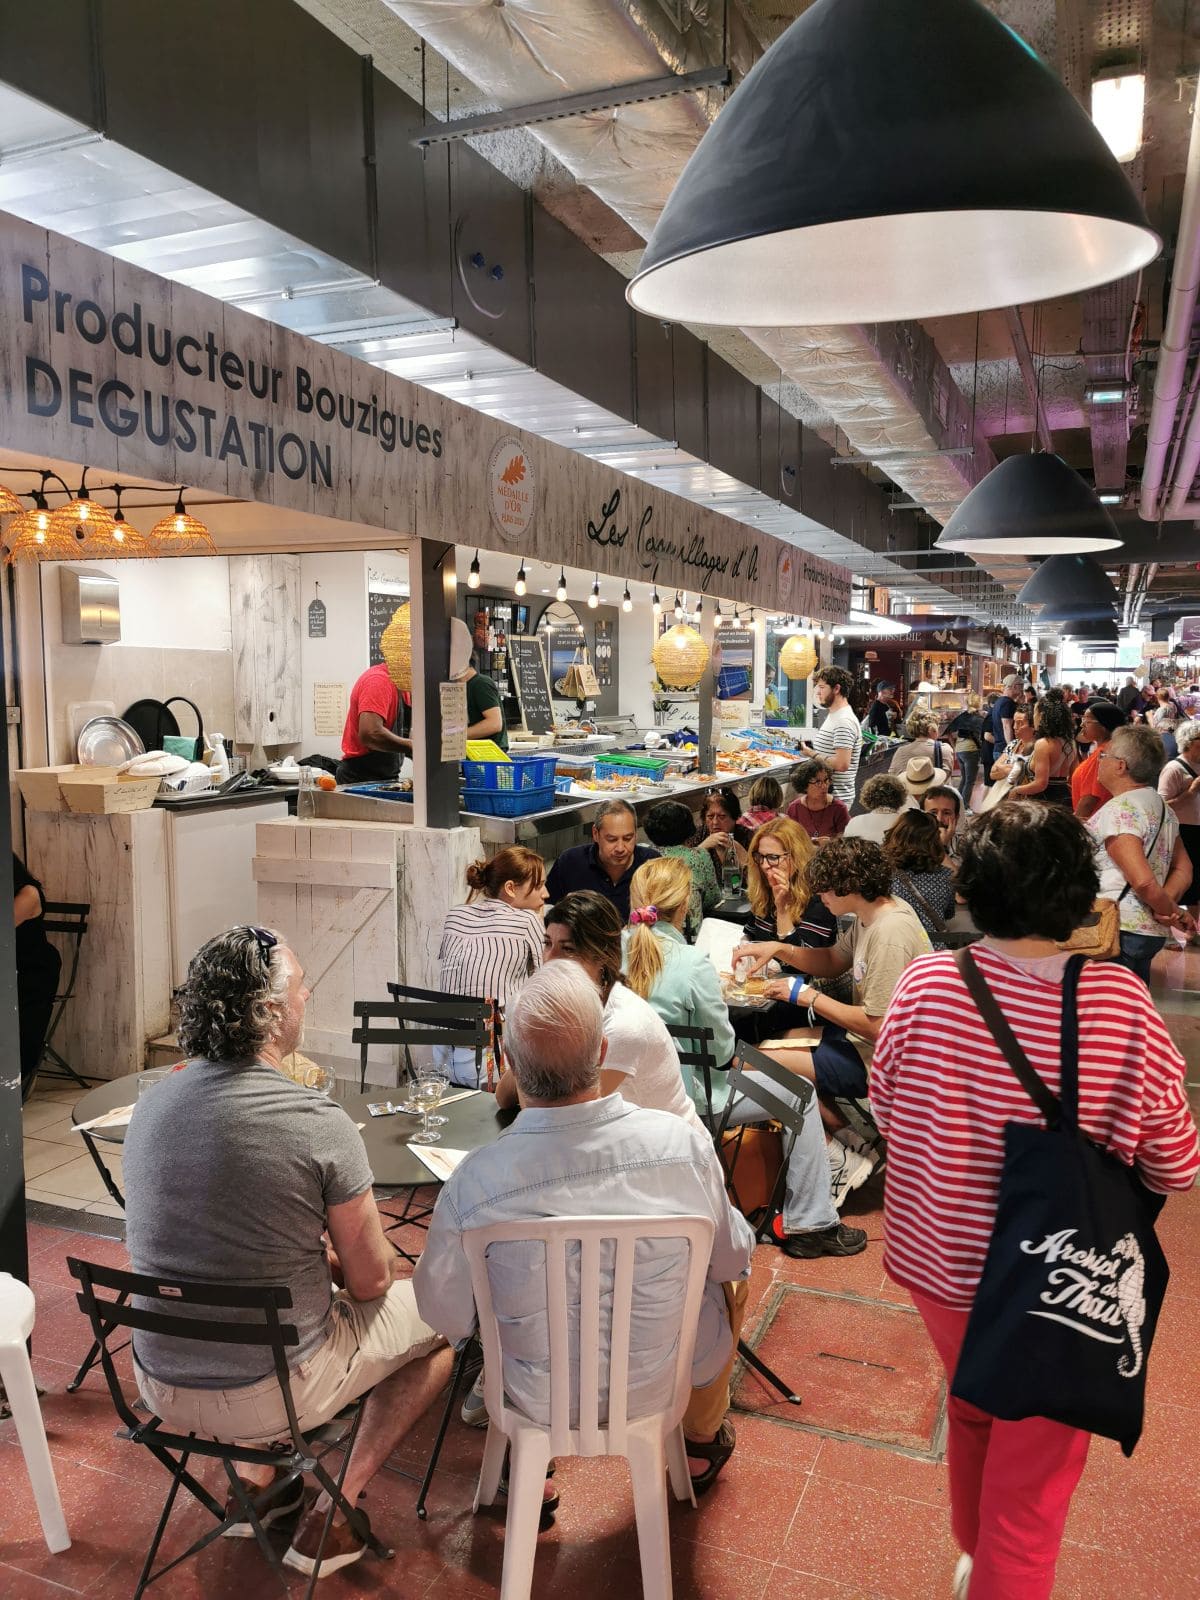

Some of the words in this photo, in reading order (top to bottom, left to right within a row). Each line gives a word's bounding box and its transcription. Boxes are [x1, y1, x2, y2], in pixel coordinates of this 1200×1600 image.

[20, 263, 283, 404] Producteur
[296, 366, 442, 458] Bouzigues
[25, 356, 333, 487] DEGUSTATION
[587, 488, 629, 547] Les
[1040, 1267, 1123, 1326] Thau
